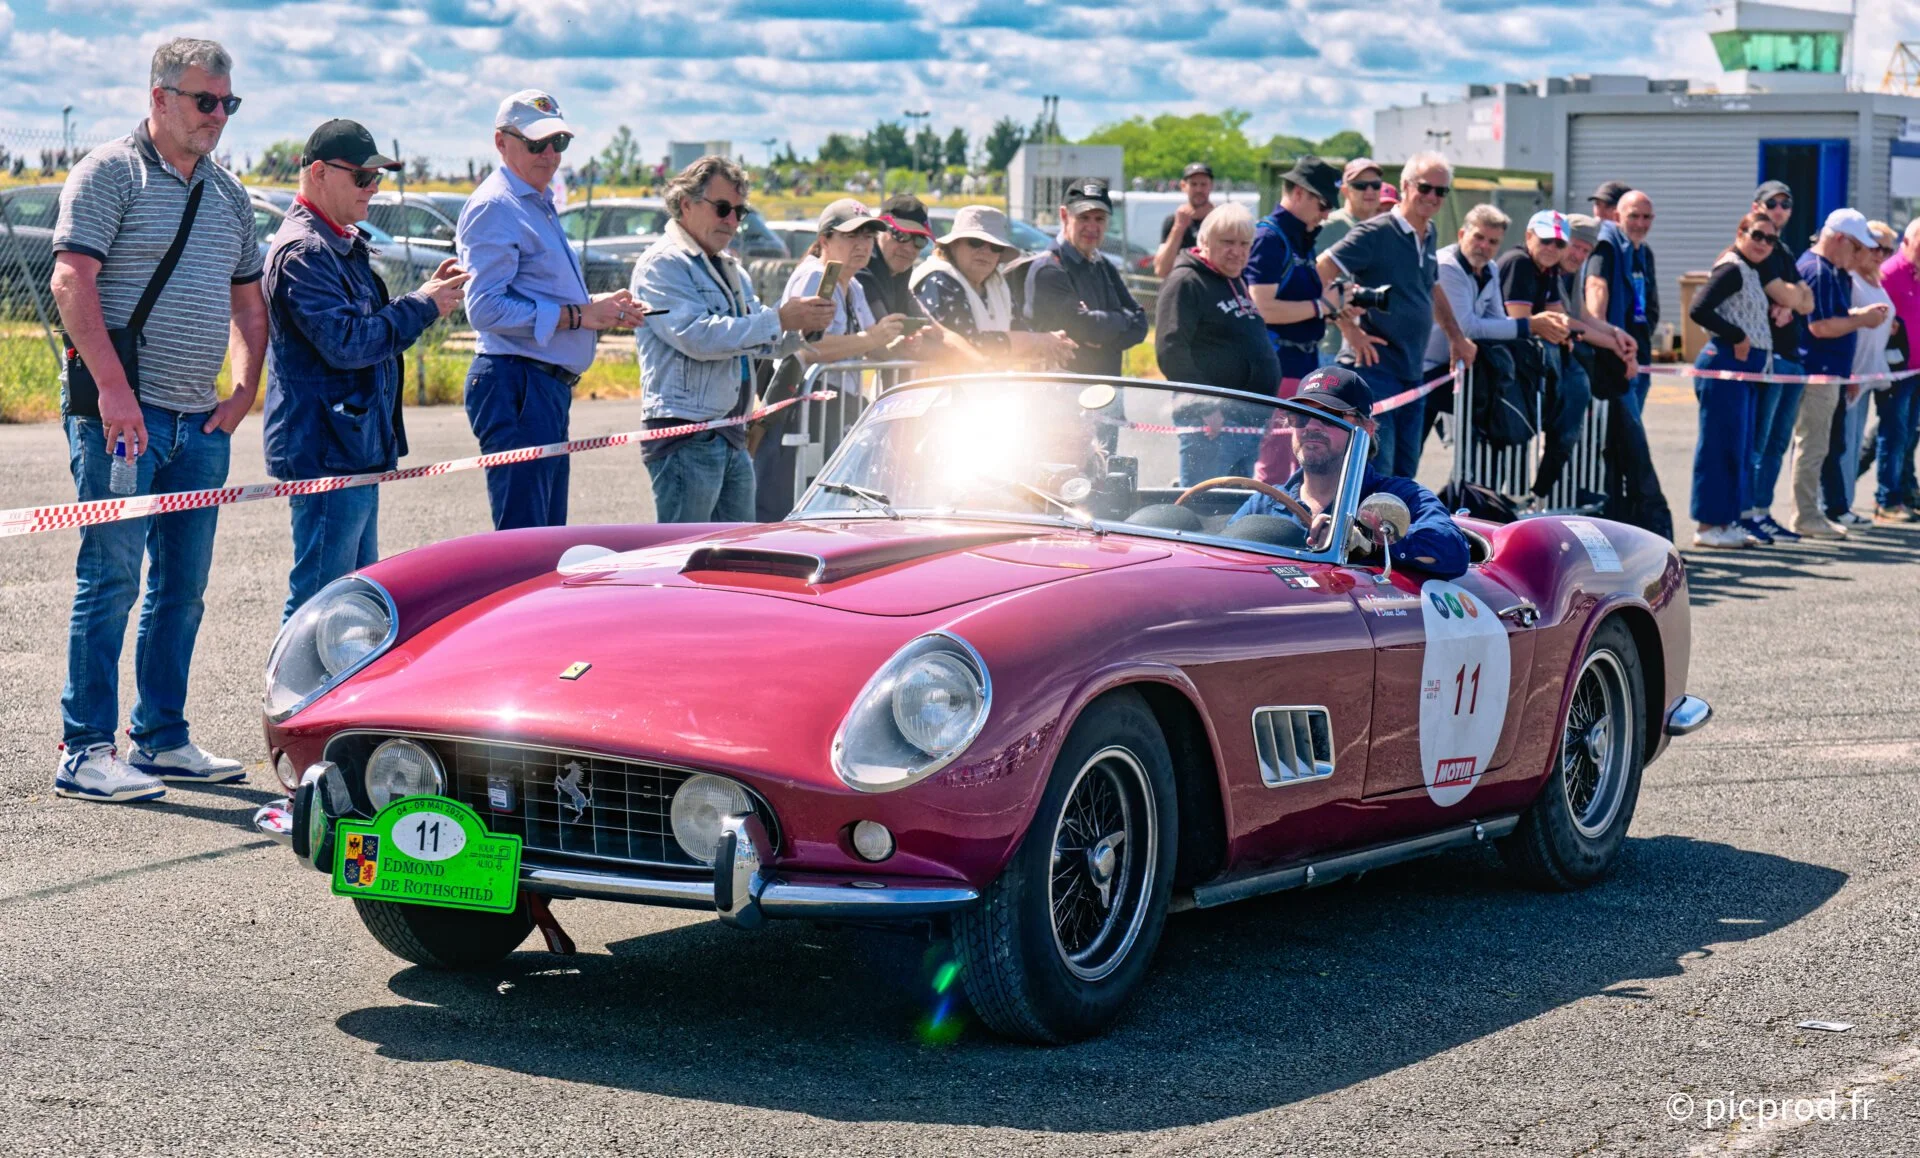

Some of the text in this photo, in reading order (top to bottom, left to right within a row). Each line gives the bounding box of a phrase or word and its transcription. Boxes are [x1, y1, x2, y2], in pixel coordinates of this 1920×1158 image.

[1454, 663, 1480, 716] 11
[1436, 761, 1473, 784] MOTUL
[396, 805, 407, 816] 04
[414, 801, 425, 810] 09
[427, 801, 443, 811] MAI
[416, 820, 440, 852] 11
[383, 857, 445, 877] EDMOND
[380, 878, 493, 901] DE ROTHSCHILD
